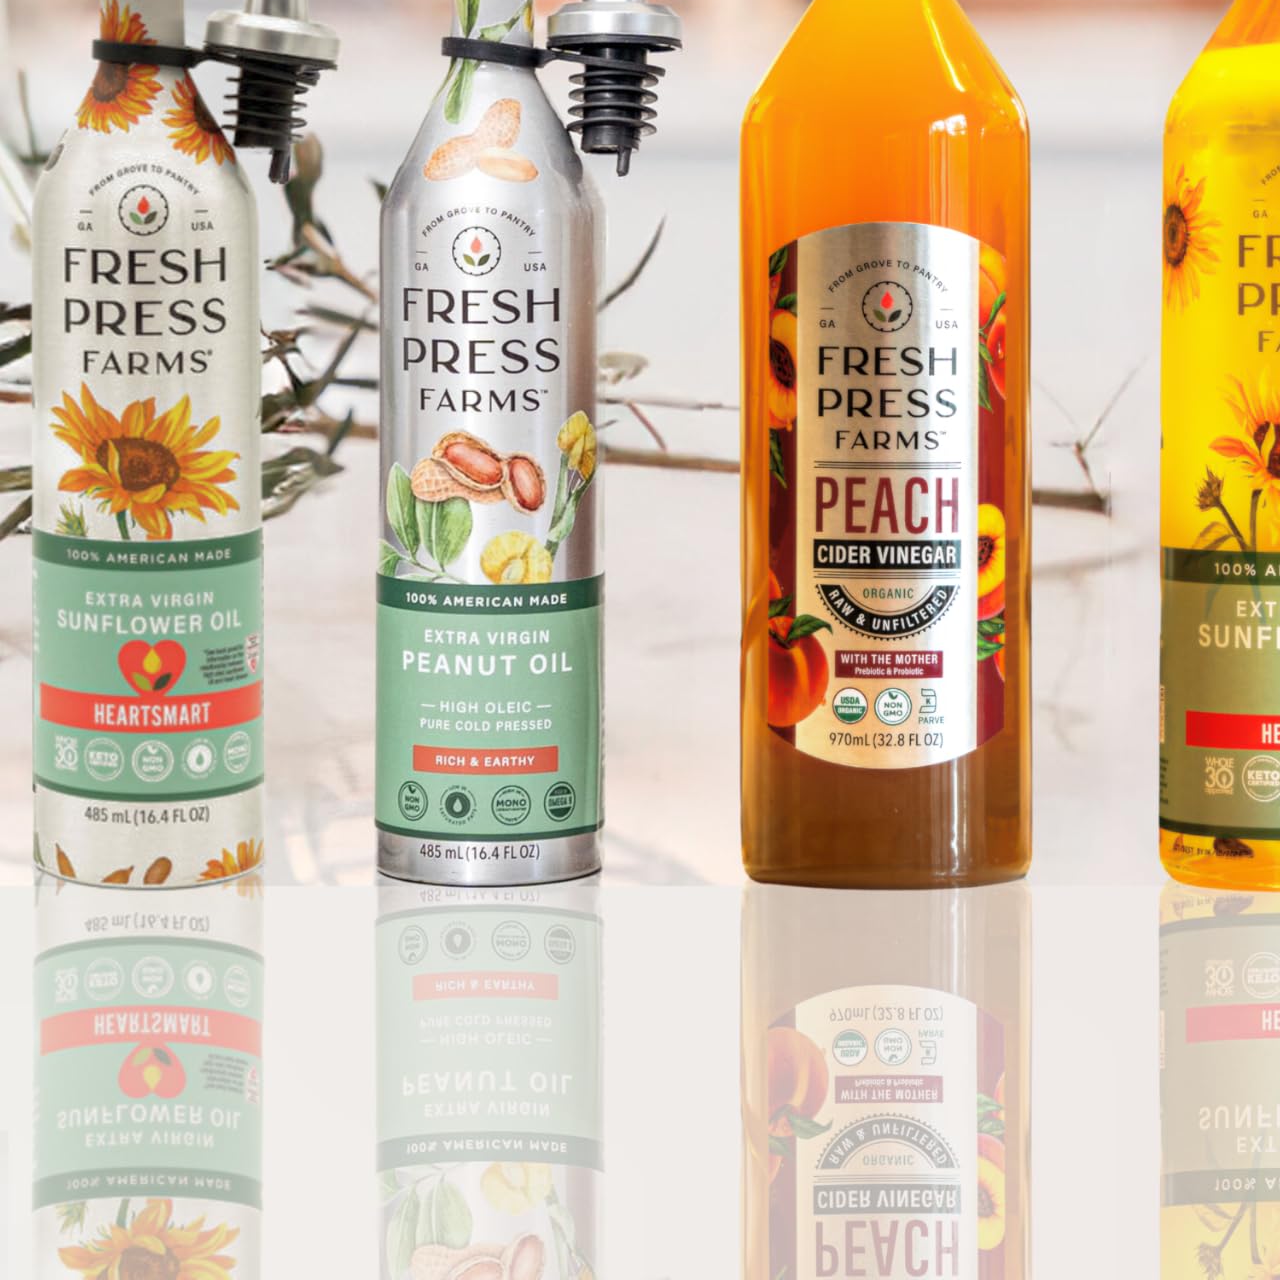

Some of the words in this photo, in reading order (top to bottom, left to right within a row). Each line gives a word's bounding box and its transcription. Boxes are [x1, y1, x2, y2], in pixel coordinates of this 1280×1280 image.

[1253, 210, 1268, 218] GA
[64, 247, 226, 285] FRESH
[415, 263, 429, 271] GA
[524, 263, 546, 272] USA
[829, 271, 854, 293] FROM
[856, 260, 893, 273] GROVE
[897, 260, 909, 269] TO
[913, 265, 947, 293] PANTRY
[403, 287, 560, 324] FRESH
[64, 298, 226, 336] PRESS
[820, 320, 835, 329] GA
[935, 320, 958, 329] USA
[403, 337, 560, 374] PRESS
[818, 346, 957, 376] FRESH
[818, 388, 957, 418] PRESS
[815, 477, 958, 534] PEACH
[67, 549, 99, 561] 100%
[107, 553, 188, 564] AMERICAN
[195, 549, 232, 561] MADE
[817, 545, 871, 564] CIDER
[876, 546, 956, 564] VINEGAR
[1214, 562, 1256, 576] 100%
[85, 592, 143, 608] EXTRA
[151, 592, 214, 607] VIRGIN
[406, 592, 437, 605] 100%
[443, 595, 523, 607] AMERICAN
[529, 593, 568, 606] MADE
[863, 588, 914, 599] ORGANIC
[828, 589, 853, 616] RAW
[856, 613, 865, 625] &
[872, 591, 947, 631] UNFILTERED
[57, 609, 202, 635] SUNFLOWER
[211, 610, 241, 631] OIL
[424, 629, 480, 645] EXTRA
[488, 630, 550, 645] VIRGIN
[402, 650, 516, 676] PEANUT
[529, 652, 572, 673] OIL
[841, 654, 868, 664] WITH
[871, 654, 891, 664] THE
[896, 654, 938, 664] MOTHER
[855, 667, 885, 675] Prebiotic
[894, 667, 923, 675] Probiotic
[440, 701, 478, 713] HIGH
[485, 701, 532, 713] OLEIC
[841, 696, 860, 704] USDA
[94, 702, 211, 726] HEARTSMART
[420, 718, 450, 730] PURE
[455, 720, 490, 731] COLD
[496, 719, 552, 731] PRESSED
[829, 732, 870, 746] 970mL
[873, 733, 904, 748] (32.8
[909, 733, 921, 745] FL
[924, 733, 943, 748] OZ)
[436, 755, 465, 766] RICH
[470, 757, 479, 766] &
[485, 755, 535, 767] EARTHY
[1204, 756, 1234, 769] WHOLE
[1205, 768, 1234, 788] 30
[1247, 770, 1280, 780] KETO
[497, 799, 526, 807] MONO
[420, 844, 441, 859] 485
[504, 846, 517, 859] FL
